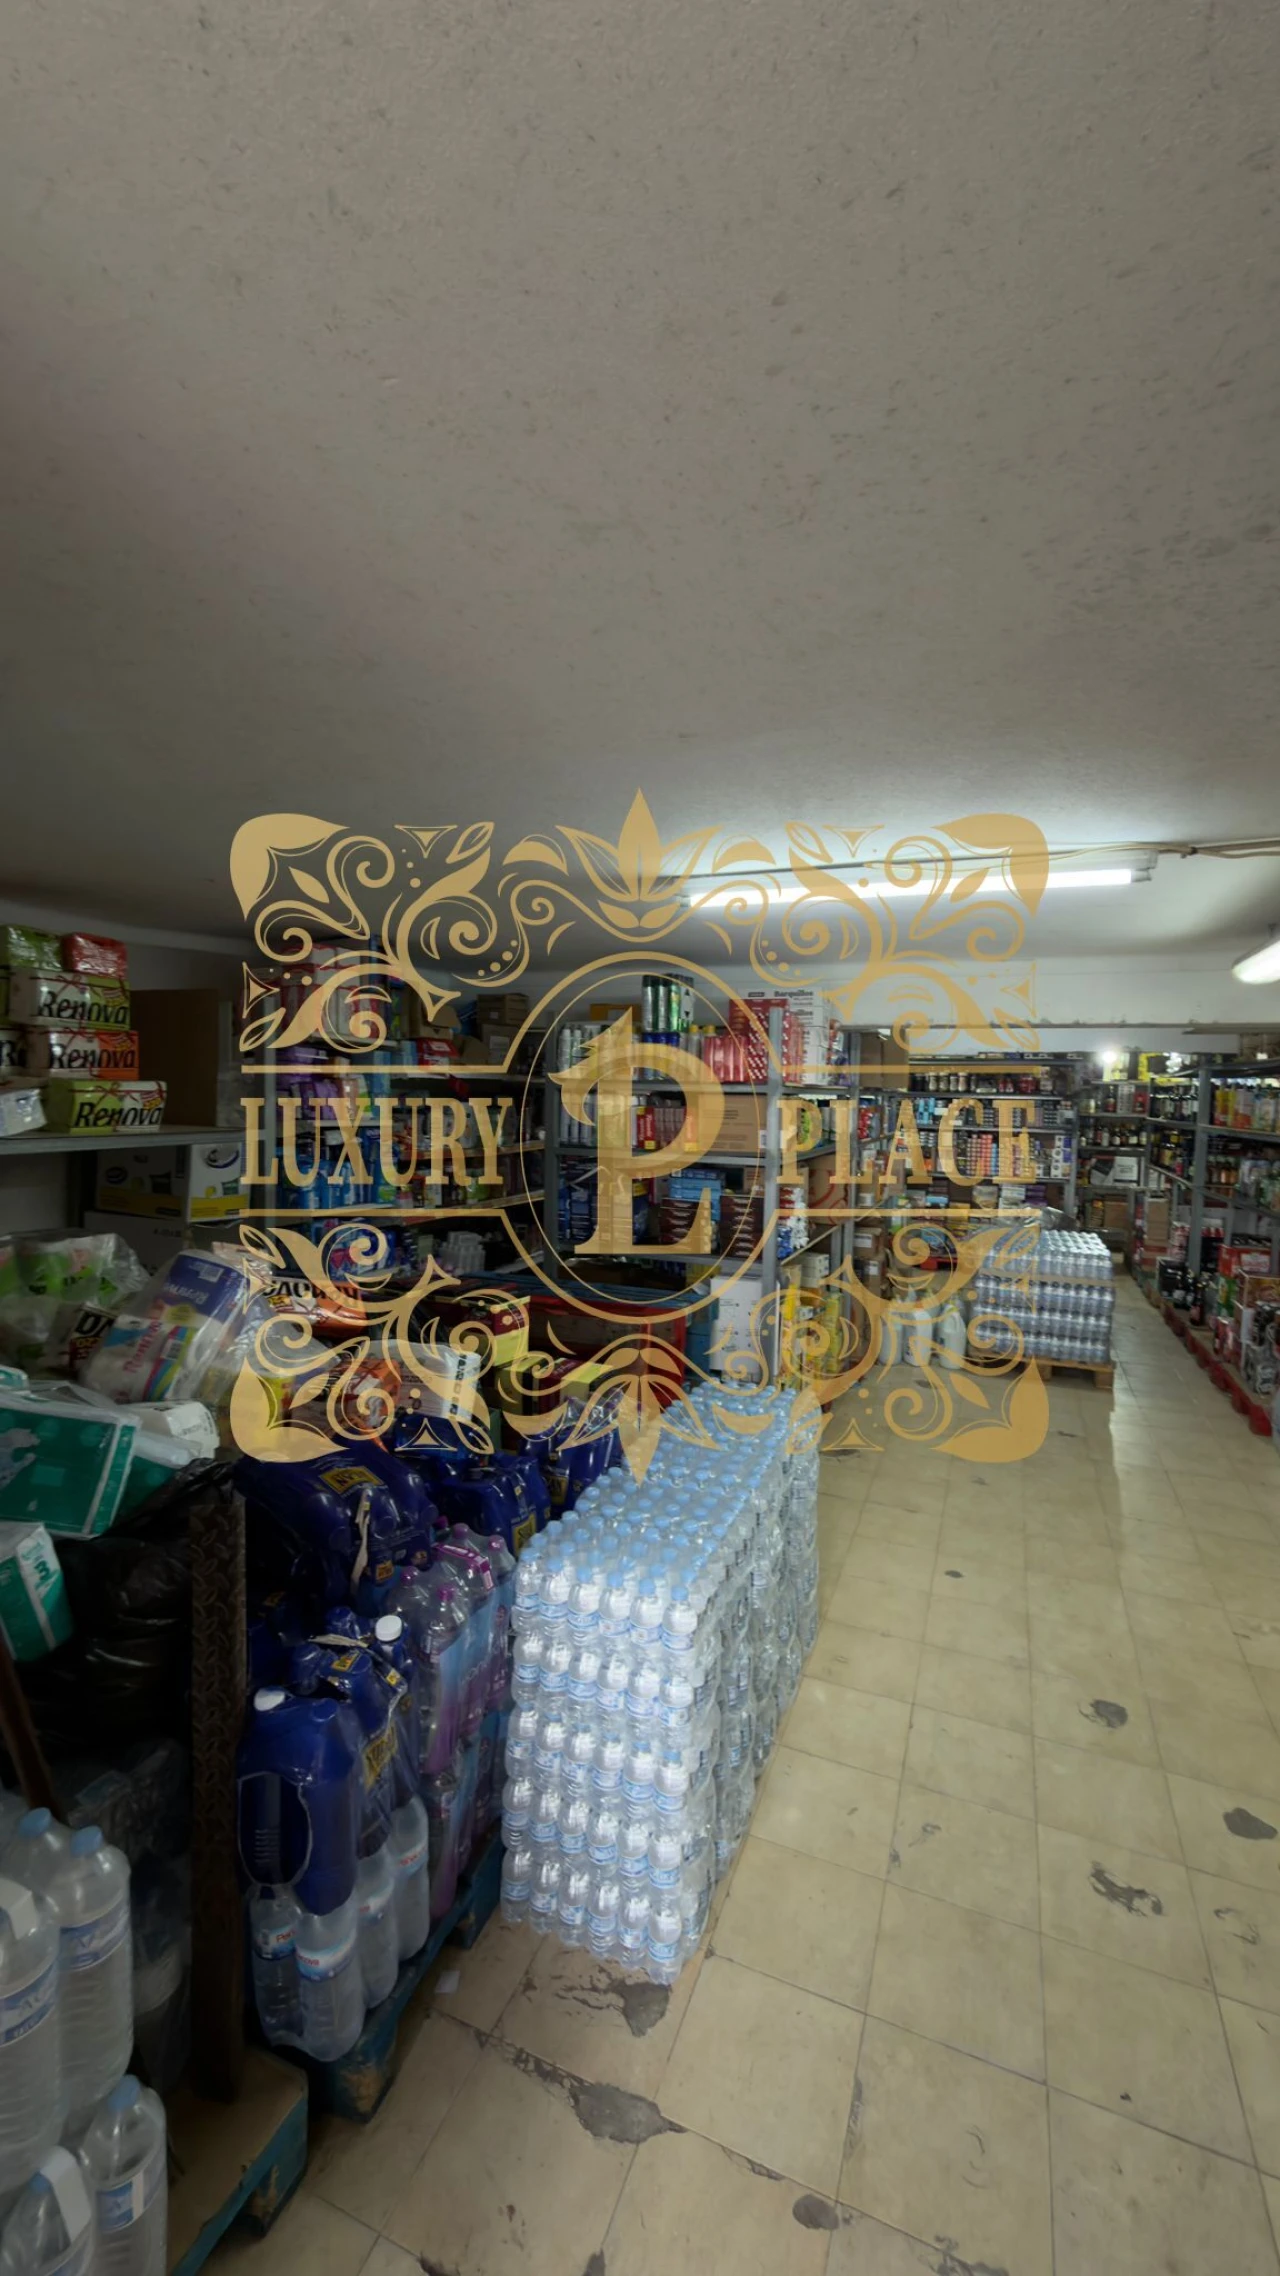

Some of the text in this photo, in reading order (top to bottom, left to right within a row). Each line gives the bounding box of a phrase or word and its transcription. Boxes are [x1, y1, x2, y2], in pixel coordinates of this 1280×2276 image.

[38, 991, 129, 1025] Renova
[49, 1043, 136, 1069] Renova
[74, 1102, 163, 1129] Renova
